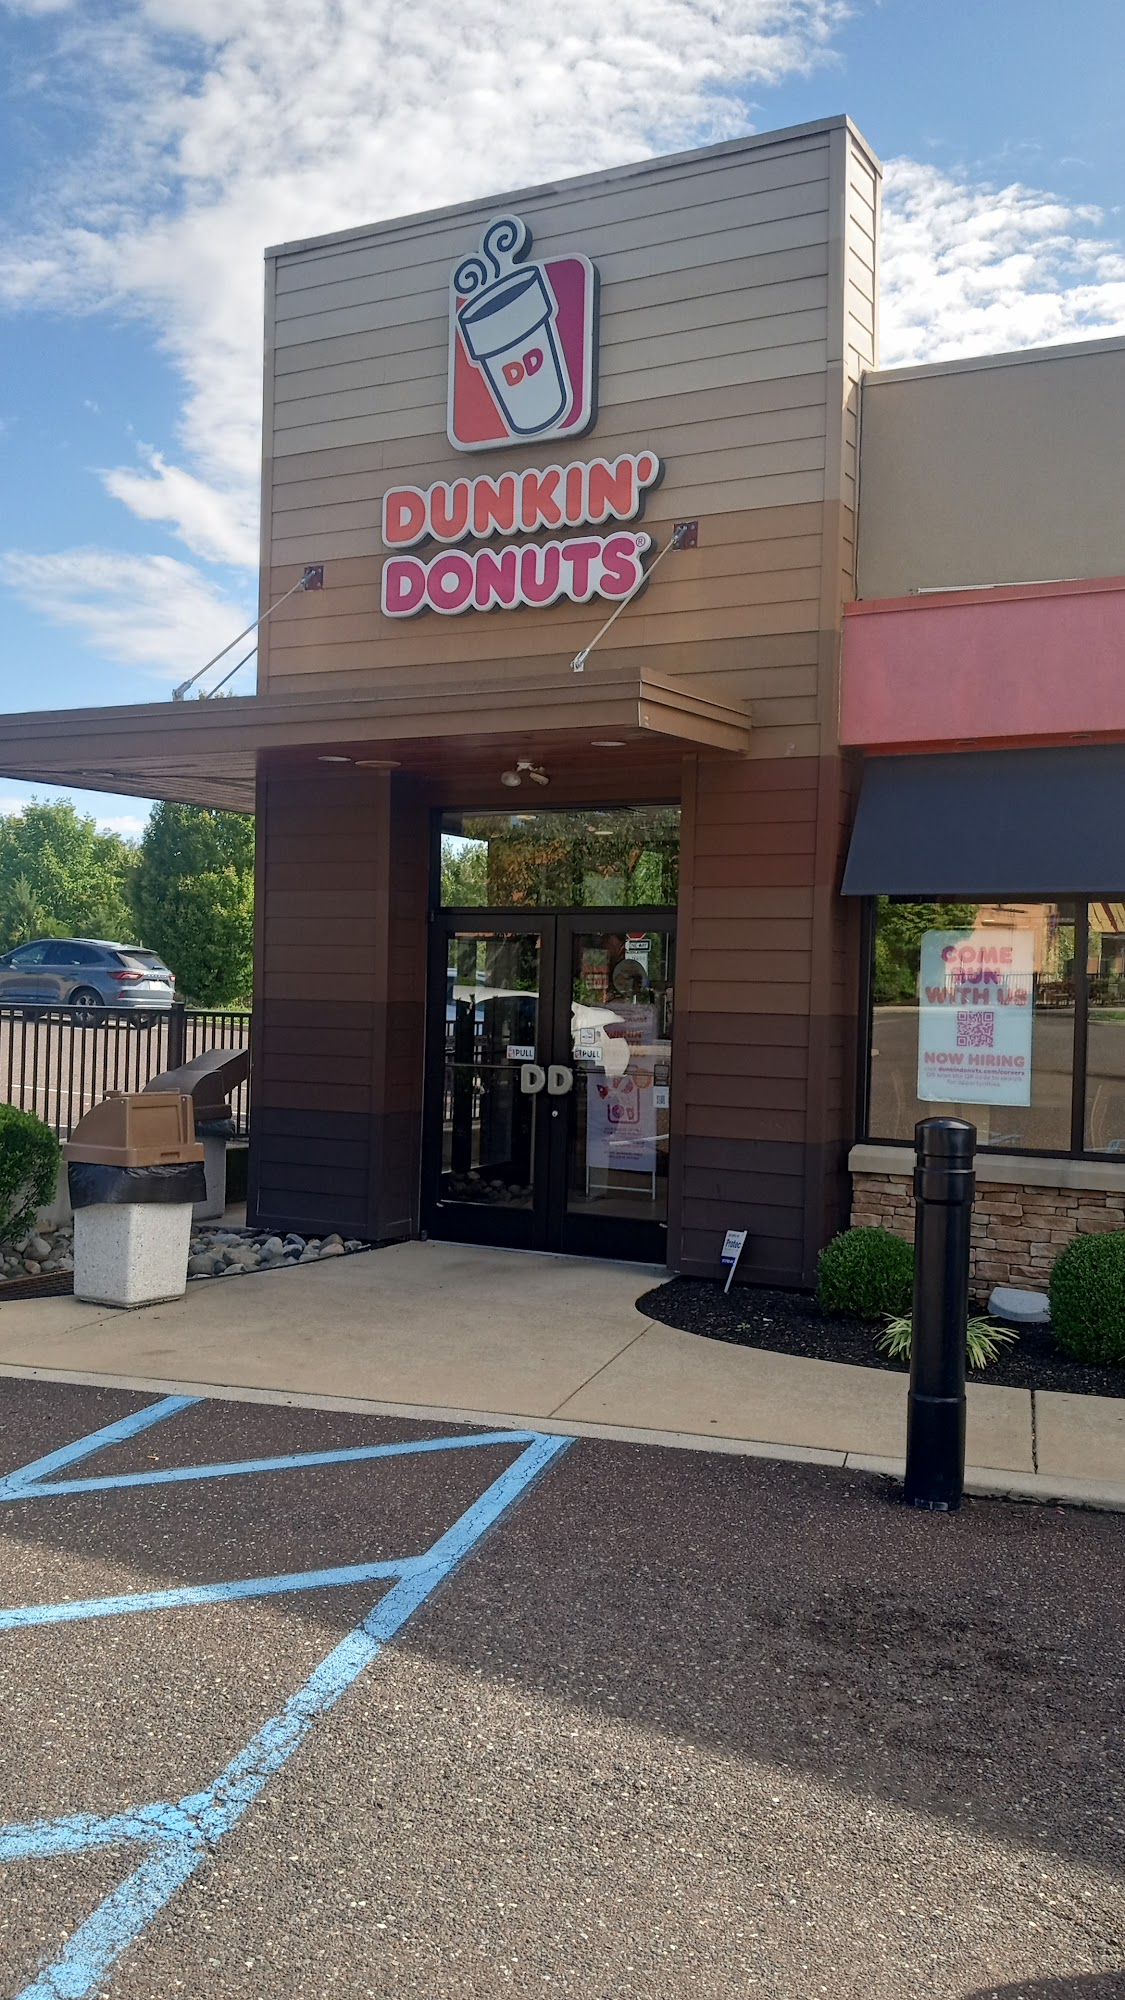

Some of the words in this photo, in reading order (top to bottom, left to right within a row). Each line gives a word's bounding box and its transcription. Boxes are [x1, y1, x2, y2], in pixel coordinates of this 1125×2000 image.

[502, 348, 543, 387] DD
[385, 456, 653, 542] DUNKIN'
[941, 945, 1013, 964] COME
[951, 966, 1000, 985] RUN
[925, 986, 989, 1006] WITH
[997, 988, 1028, 1007] US
[515, 1049, 533, 1057] PULL
[582, 1049, 600, 1058] PULL
[924, 1052, 964, 1065] NOW
[968, 1053, 1025, 1068] HIRING
